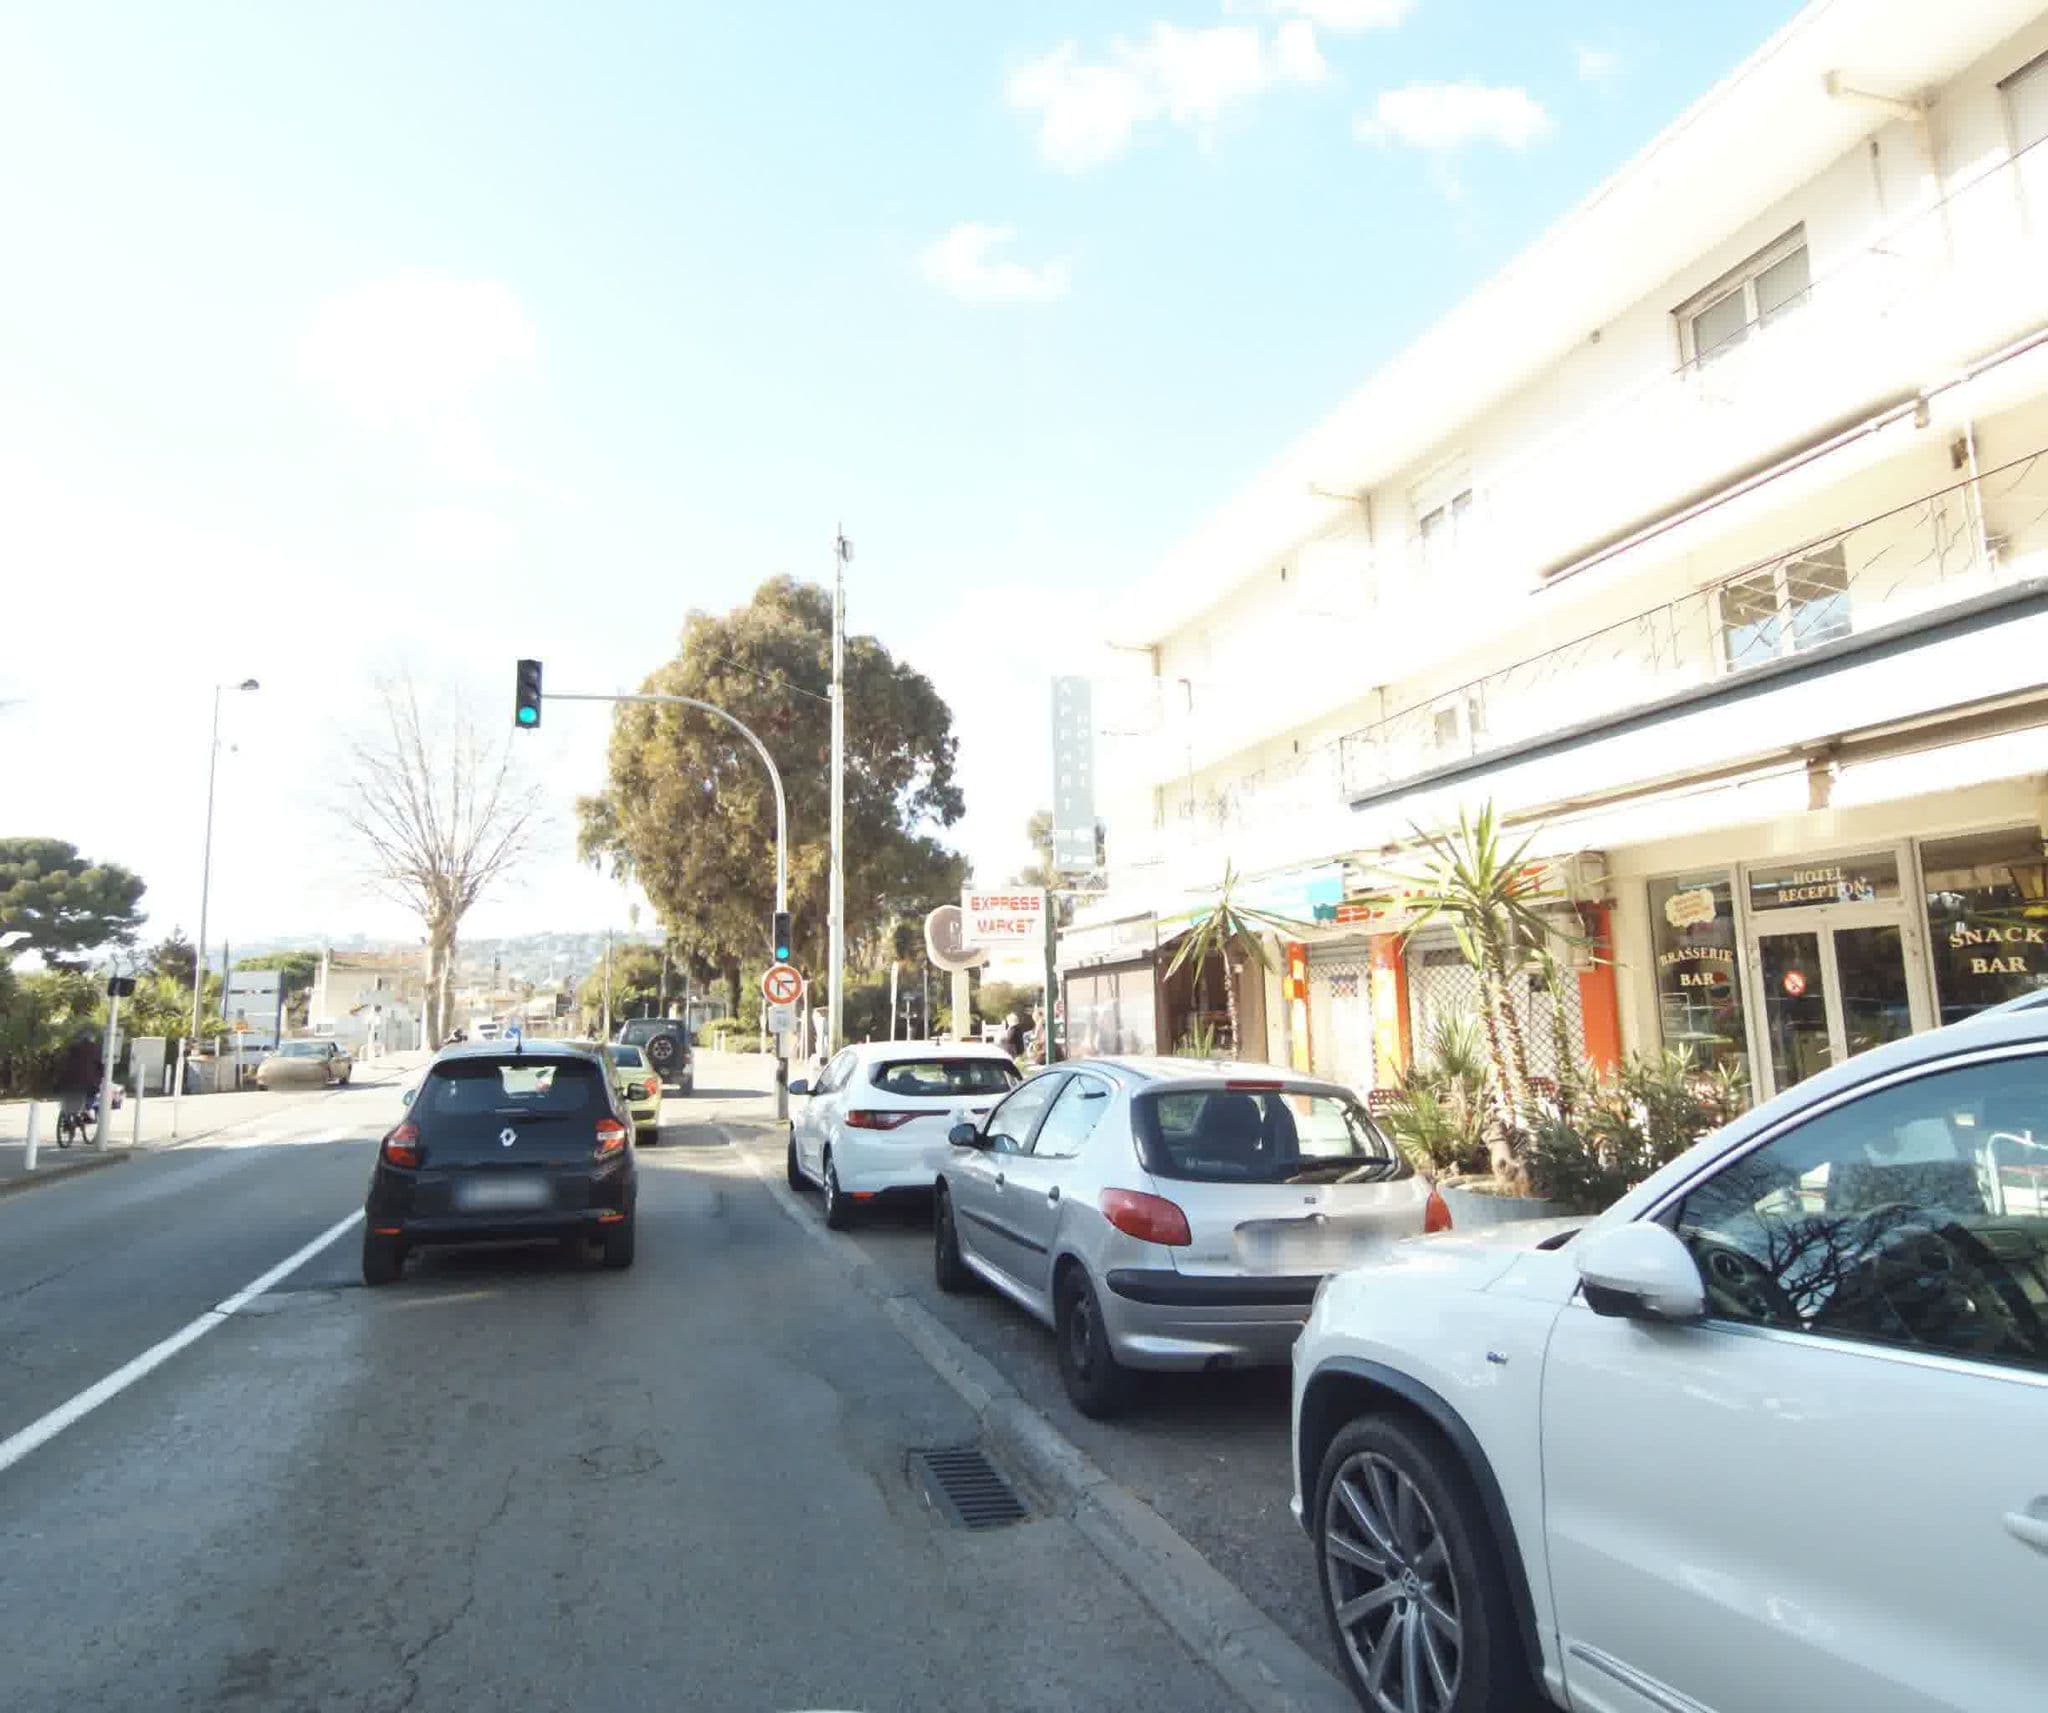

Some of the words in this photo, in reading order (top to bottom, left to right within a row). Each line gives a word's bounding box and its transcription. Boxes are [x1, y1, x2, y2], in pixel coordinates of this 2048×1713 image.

[1793, 866, 1842, 885] HOTEL
[1778, 876, 1867, 903] RECEPTION
[971, 896, 1040, 911] EXPRESS
[977, 918, 1036, 934] MARKET
[1949, 927, 2044, 949] SNACK
[1660, 946, 1733, 967] BRASSERIE
[1972, 956, 2028, 974] BAR
[1680, 972, 1714, 986] BAR
